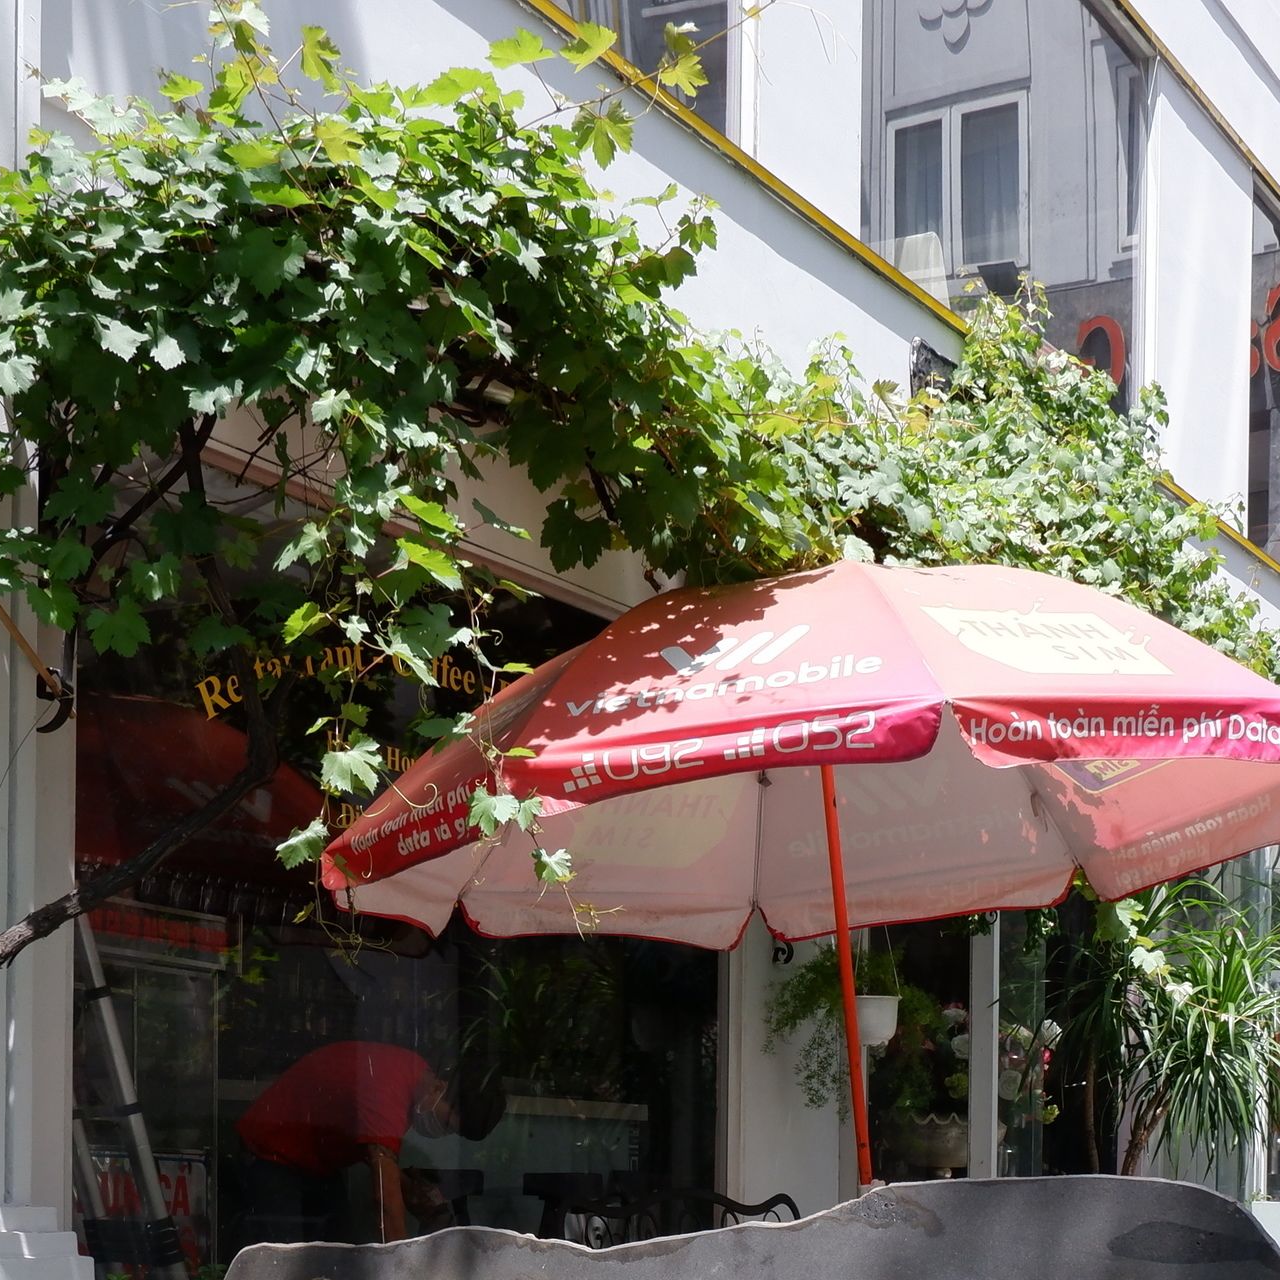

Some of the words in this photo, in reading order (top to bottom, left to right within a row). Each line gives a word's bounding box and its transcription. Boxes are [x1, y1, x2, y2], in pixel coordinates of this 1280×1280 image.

[1051, 645, 1140, 662] SIM
[566, 653, 883, 718] vietnamobile
[772, 710, 876, 754] 052
[970, 711, 1042, 745] Hoàn
[1046, 707, 1106, 739] toàn
[1112, 703, 1175, 737] miễn
[1182, 709, 1222, 744] phí
